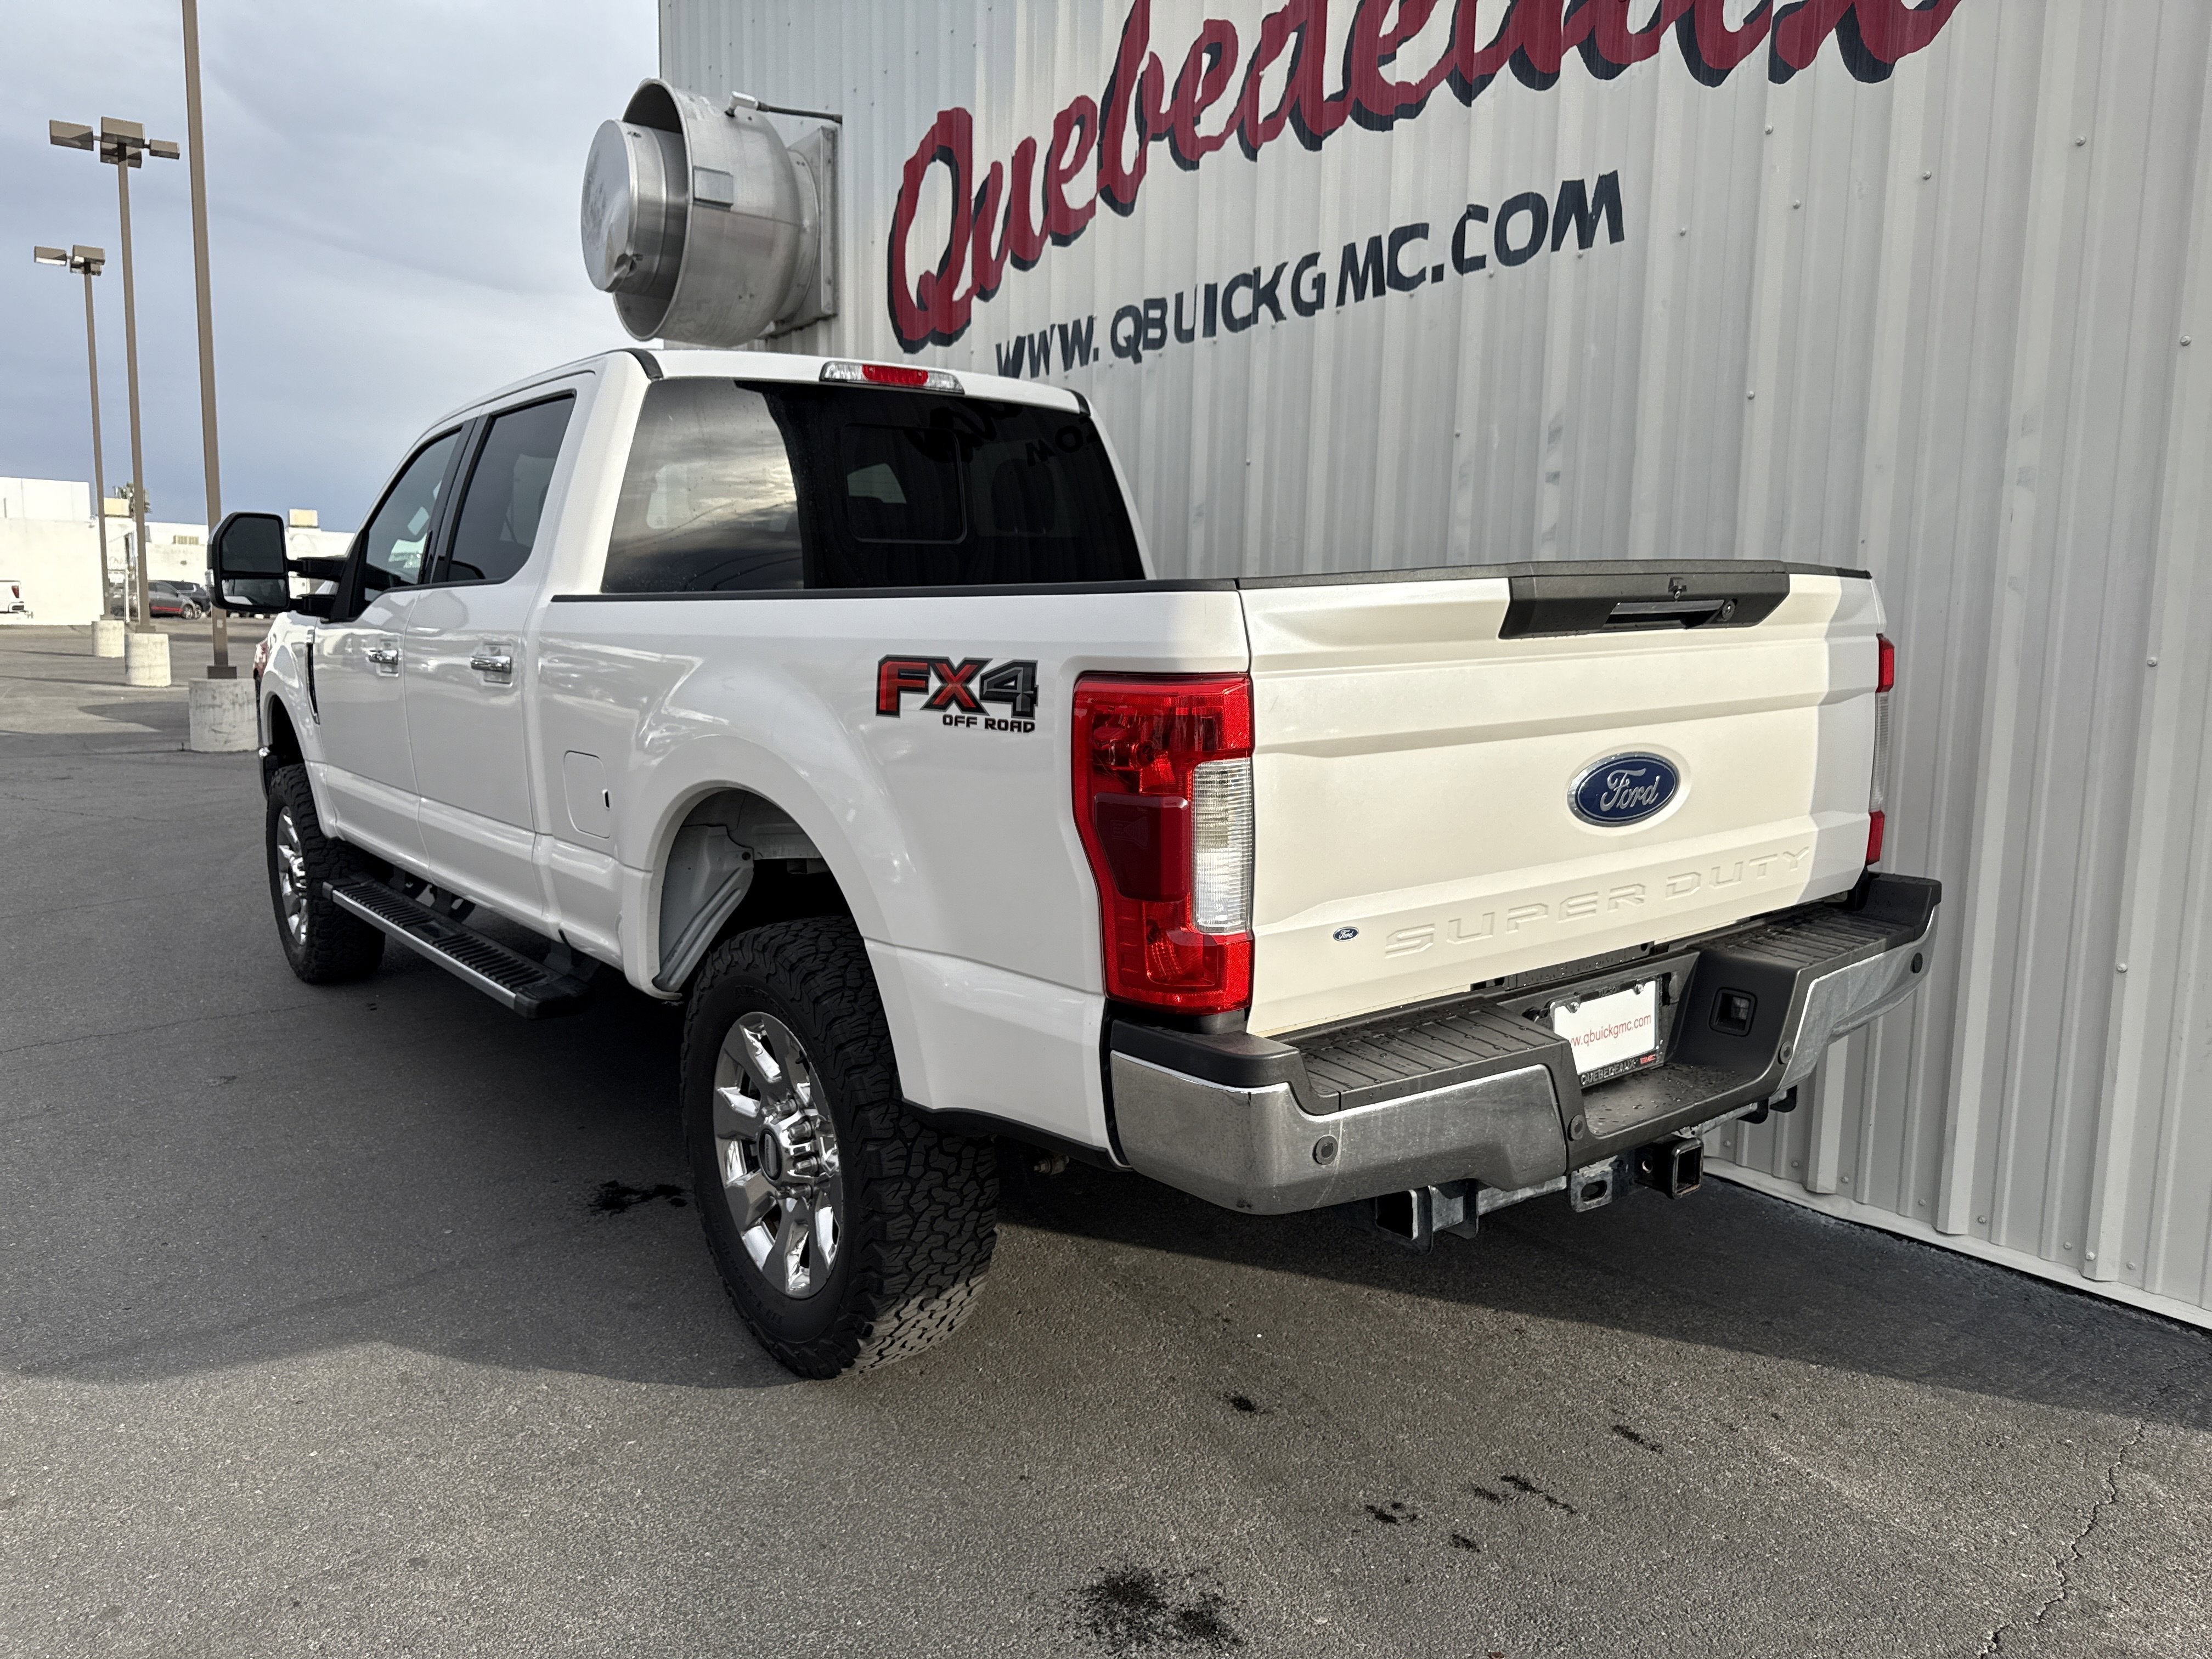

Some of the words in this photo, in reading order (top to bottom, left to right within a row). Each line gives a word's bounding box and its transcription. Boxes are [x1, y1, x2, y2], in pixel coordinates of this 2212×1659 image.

[876, 654, 1039, 721] FX4
[942, 714, 978, 728] OFF
[984, 717, 1036, 733] ROAD
[1600, 768, 1660, 812] Ford
[1384, 883, 1646, 960] SUPER
[1666, 846, 1810, 900] DUTY
[1339, 929, 1354, 939] Ford
[1571, 1014, 1651, 1047] w.qbuickgmc.com
[1581, 1058, 1635, 1085] QUEBEDEAUX
